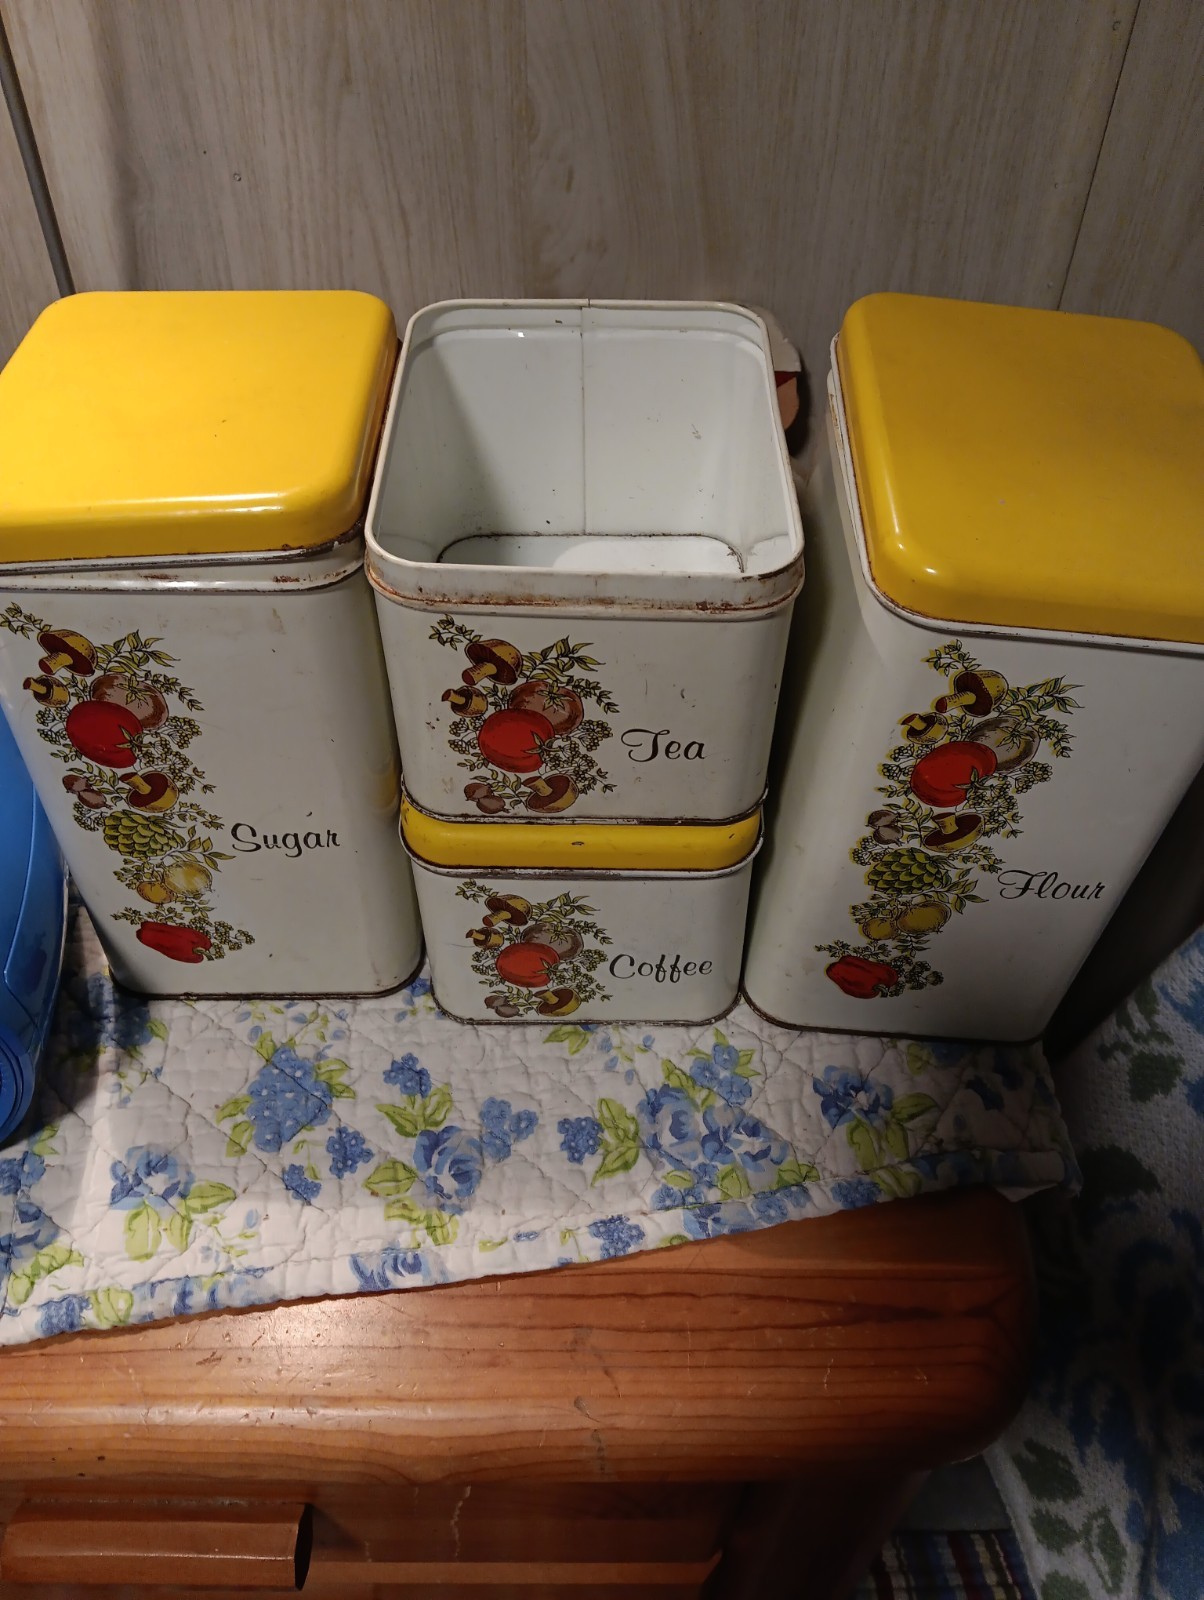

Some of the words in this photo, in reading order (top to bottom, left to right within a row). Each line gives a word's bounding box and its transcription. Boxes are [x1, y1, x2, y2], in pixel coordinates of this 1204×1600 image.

[620, 728, 705, 763] Tea
[230, 822, 341, 858] Sugar
[996, 869, 1106, 901] Flour
[608, 953, 713, 984] Coffee
